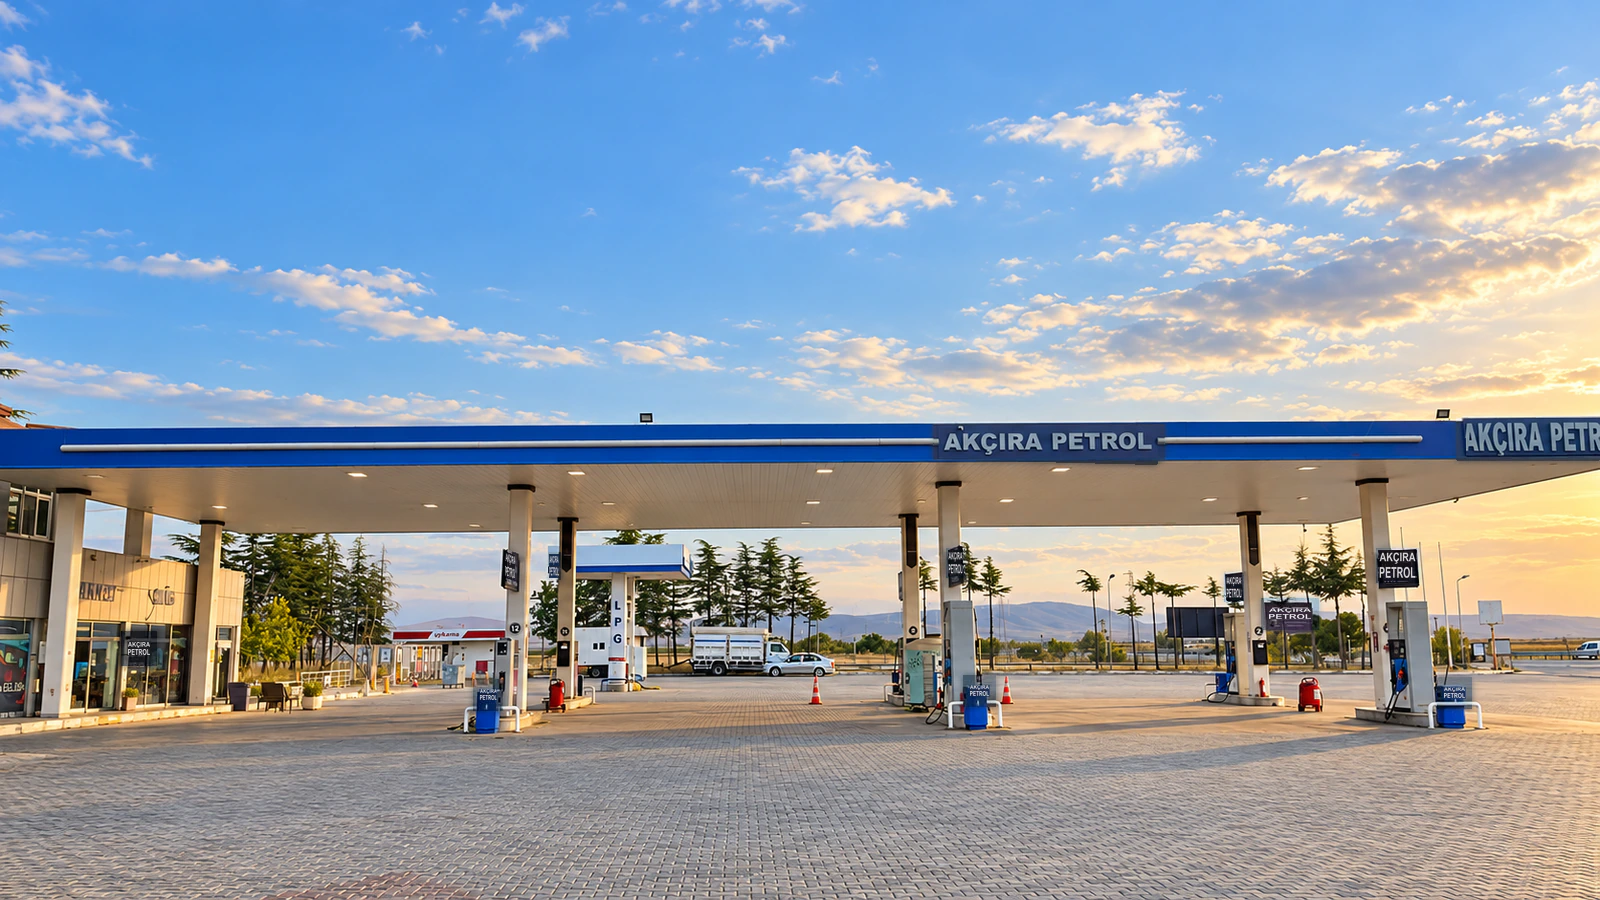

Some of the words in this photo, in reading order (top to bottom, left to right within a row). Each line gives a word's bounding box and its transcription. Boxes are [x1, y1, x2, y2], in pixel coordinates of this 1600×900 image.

[944, 432, 1042, 455] AKÇIRA
[1052, 432, 1152, 450] PETROL
[1465, 422, 1545, 456] AKÇIRA
[1379, 552, 1416, 565] AKÇIRA
[1379, 566, 1416, 579] PETROL
[1226, 588, 1242, 598] PETROL
[613, 600, 622, 644] LPG
[127, 641, 151, 649] AKÇIRA
[127, 648, 151, 656] PETROL
